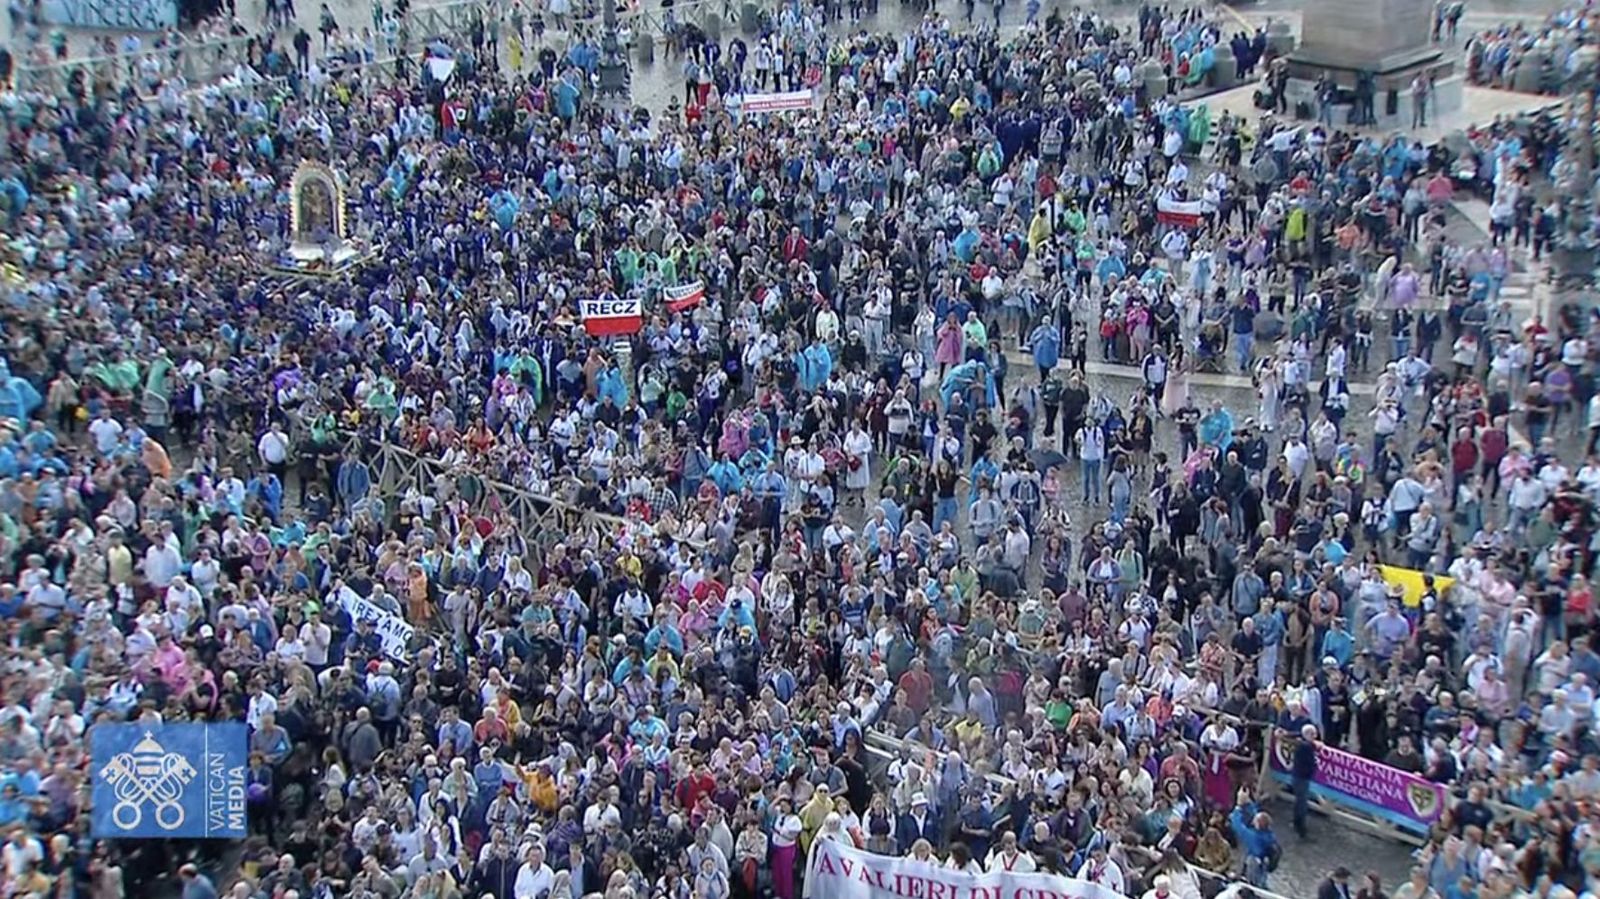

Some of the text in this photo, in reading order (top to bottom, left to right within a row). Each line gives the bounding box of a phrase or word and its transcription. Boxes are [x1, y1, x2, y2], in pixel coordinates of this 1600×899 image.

[587, 302, 637, 315] RECZ
[1314, 756, 1404, 801] VARISTIANA
[1318, 748, 1403, 786] OMPAGNIA
